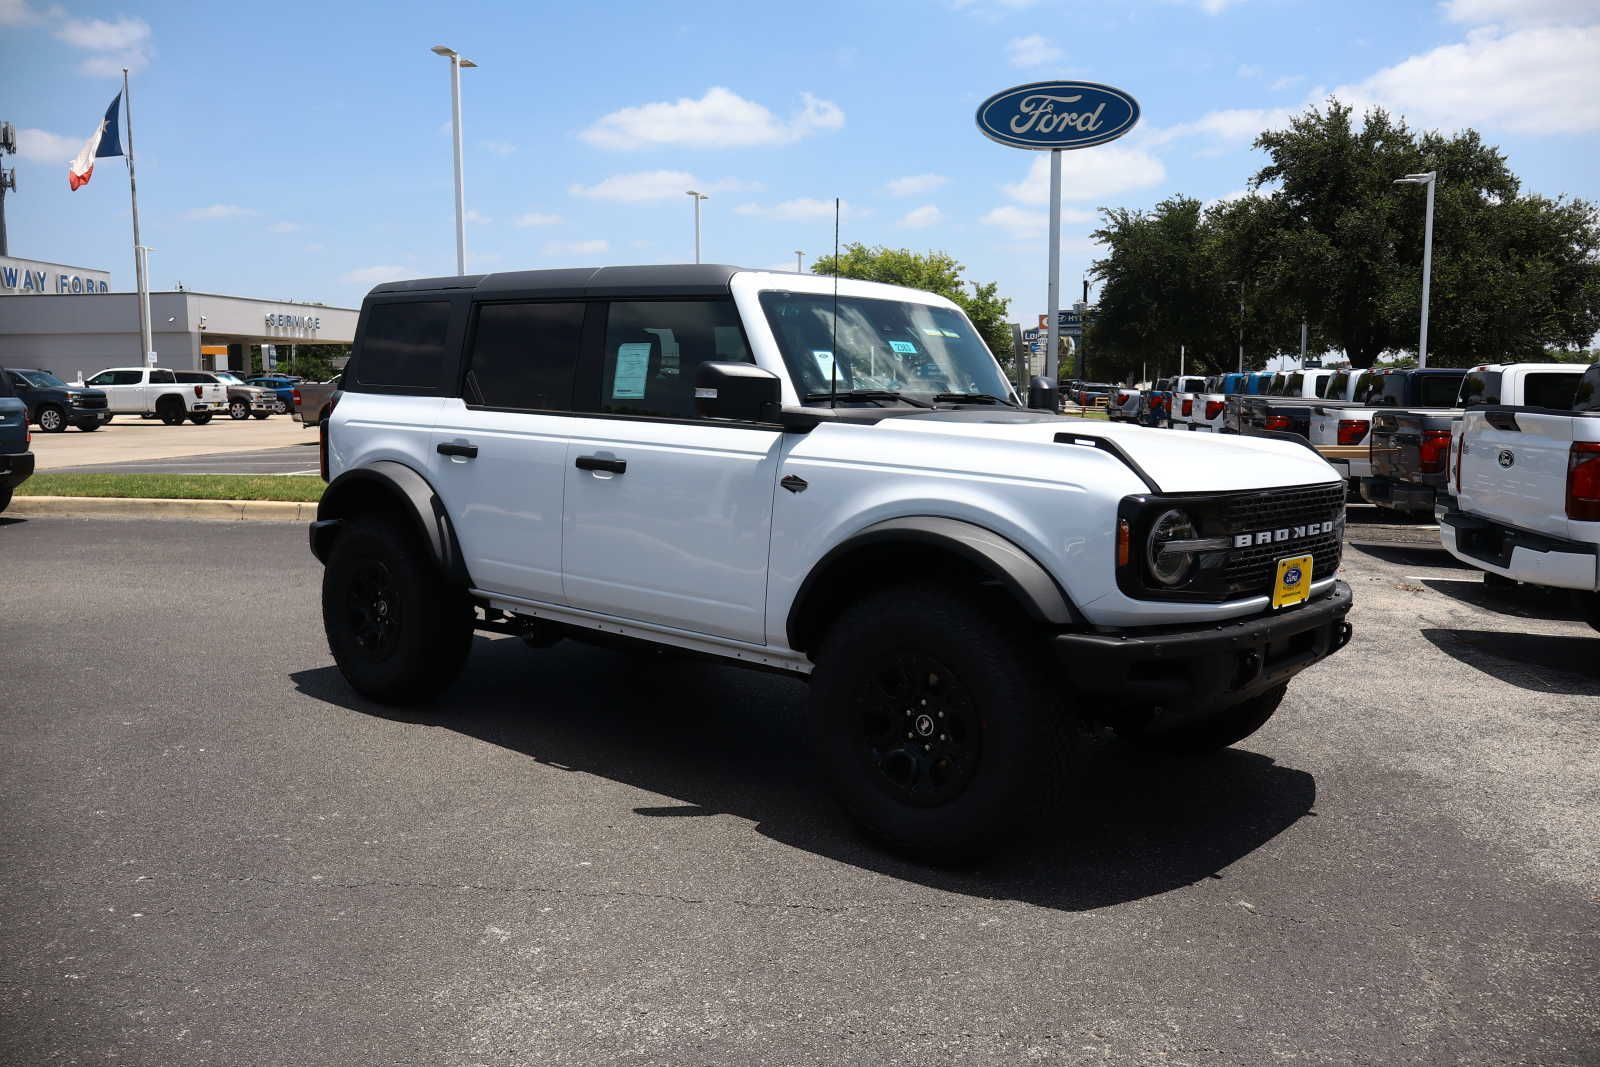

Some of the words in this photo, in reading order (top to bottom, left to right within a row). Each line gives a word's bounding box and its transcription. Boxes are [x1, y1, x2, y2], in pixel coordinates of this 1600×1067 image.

[1010, 94, 1106, 134] Ford
[58, 274, 109, 294] FORD
[268, 313, 321, 330] SERVICE
[1234, 521, 1333, 548] BRONCO
